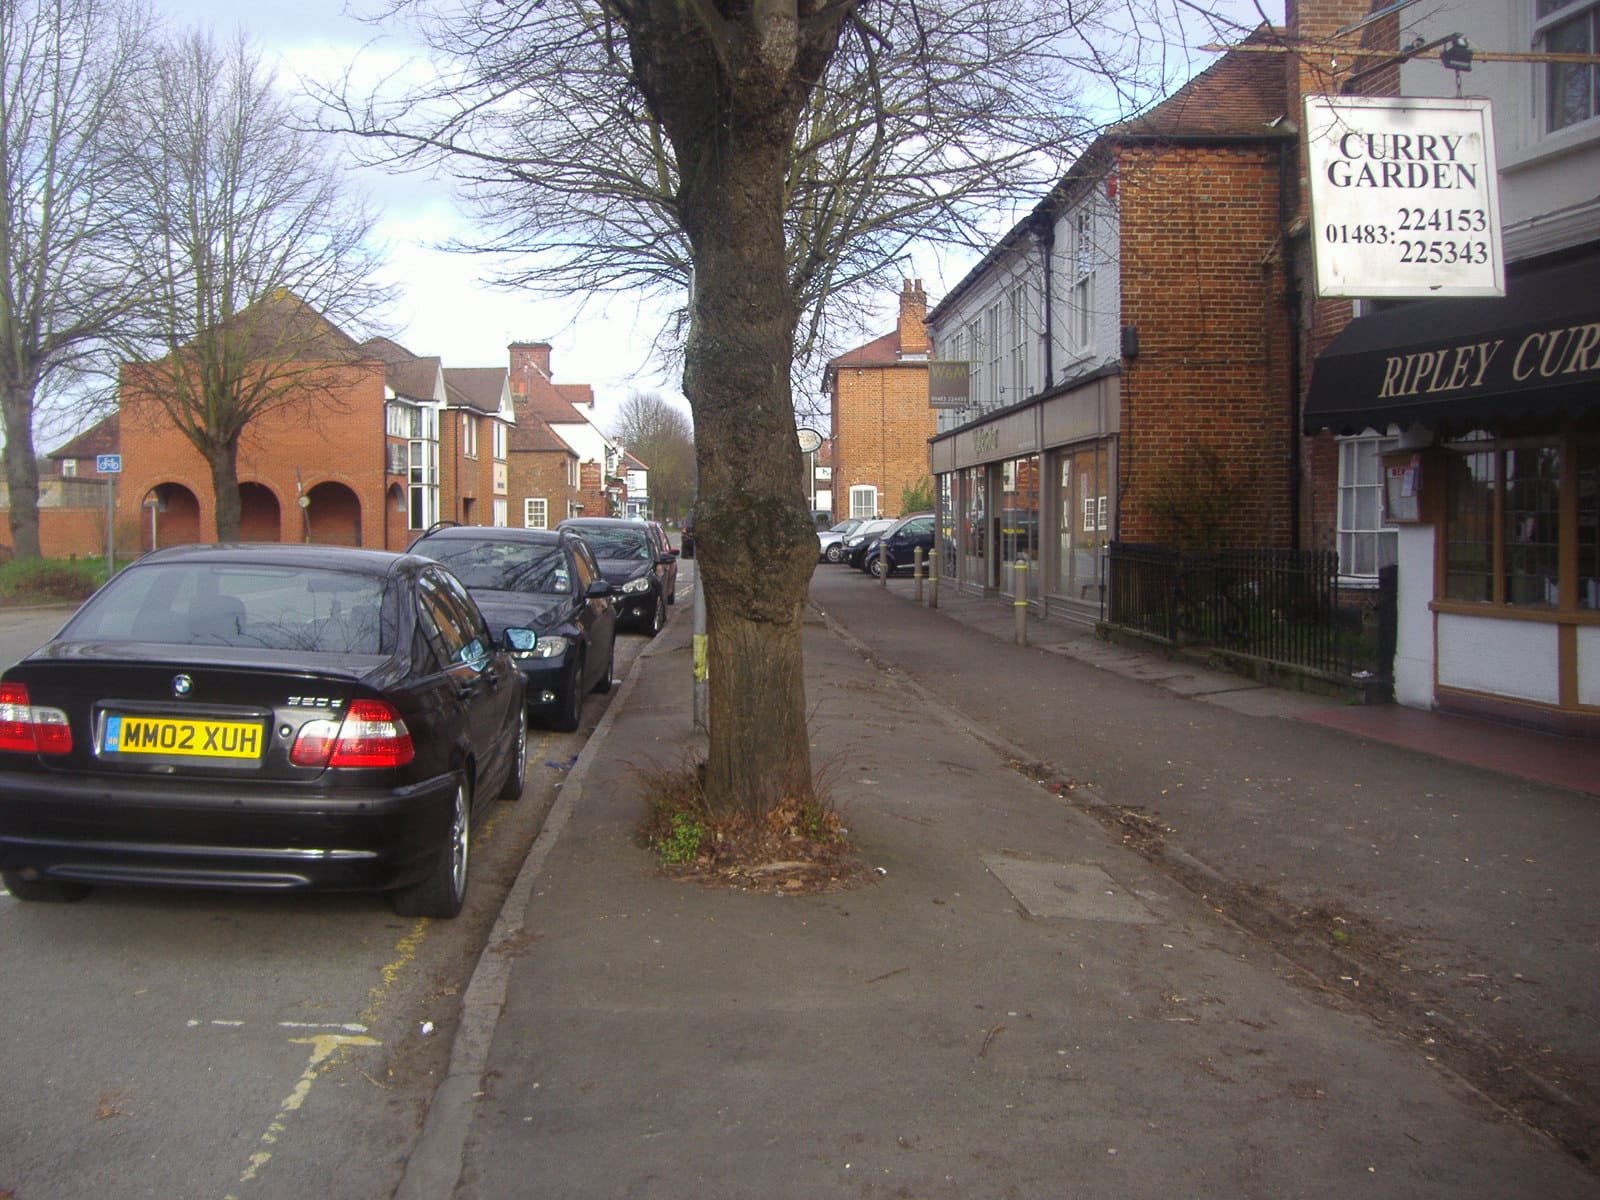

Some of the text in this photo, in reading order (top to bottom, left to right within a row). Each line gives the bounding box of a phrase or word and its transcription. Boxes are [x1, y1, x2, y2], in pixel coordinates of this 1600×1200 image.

[1339, 133, 1463, 161] CURRY
[1327, 160, 1478, 189] GARDEN
[1398, 207, 1487, 232] 224153
[1326, 223, 1396, 245] 01483:
[1399, 241, 1488, 265] 225343
[1377, 322, 1600, 398] RIPLEY CUR
[124, 722, 257, 753] MM02 XUH
